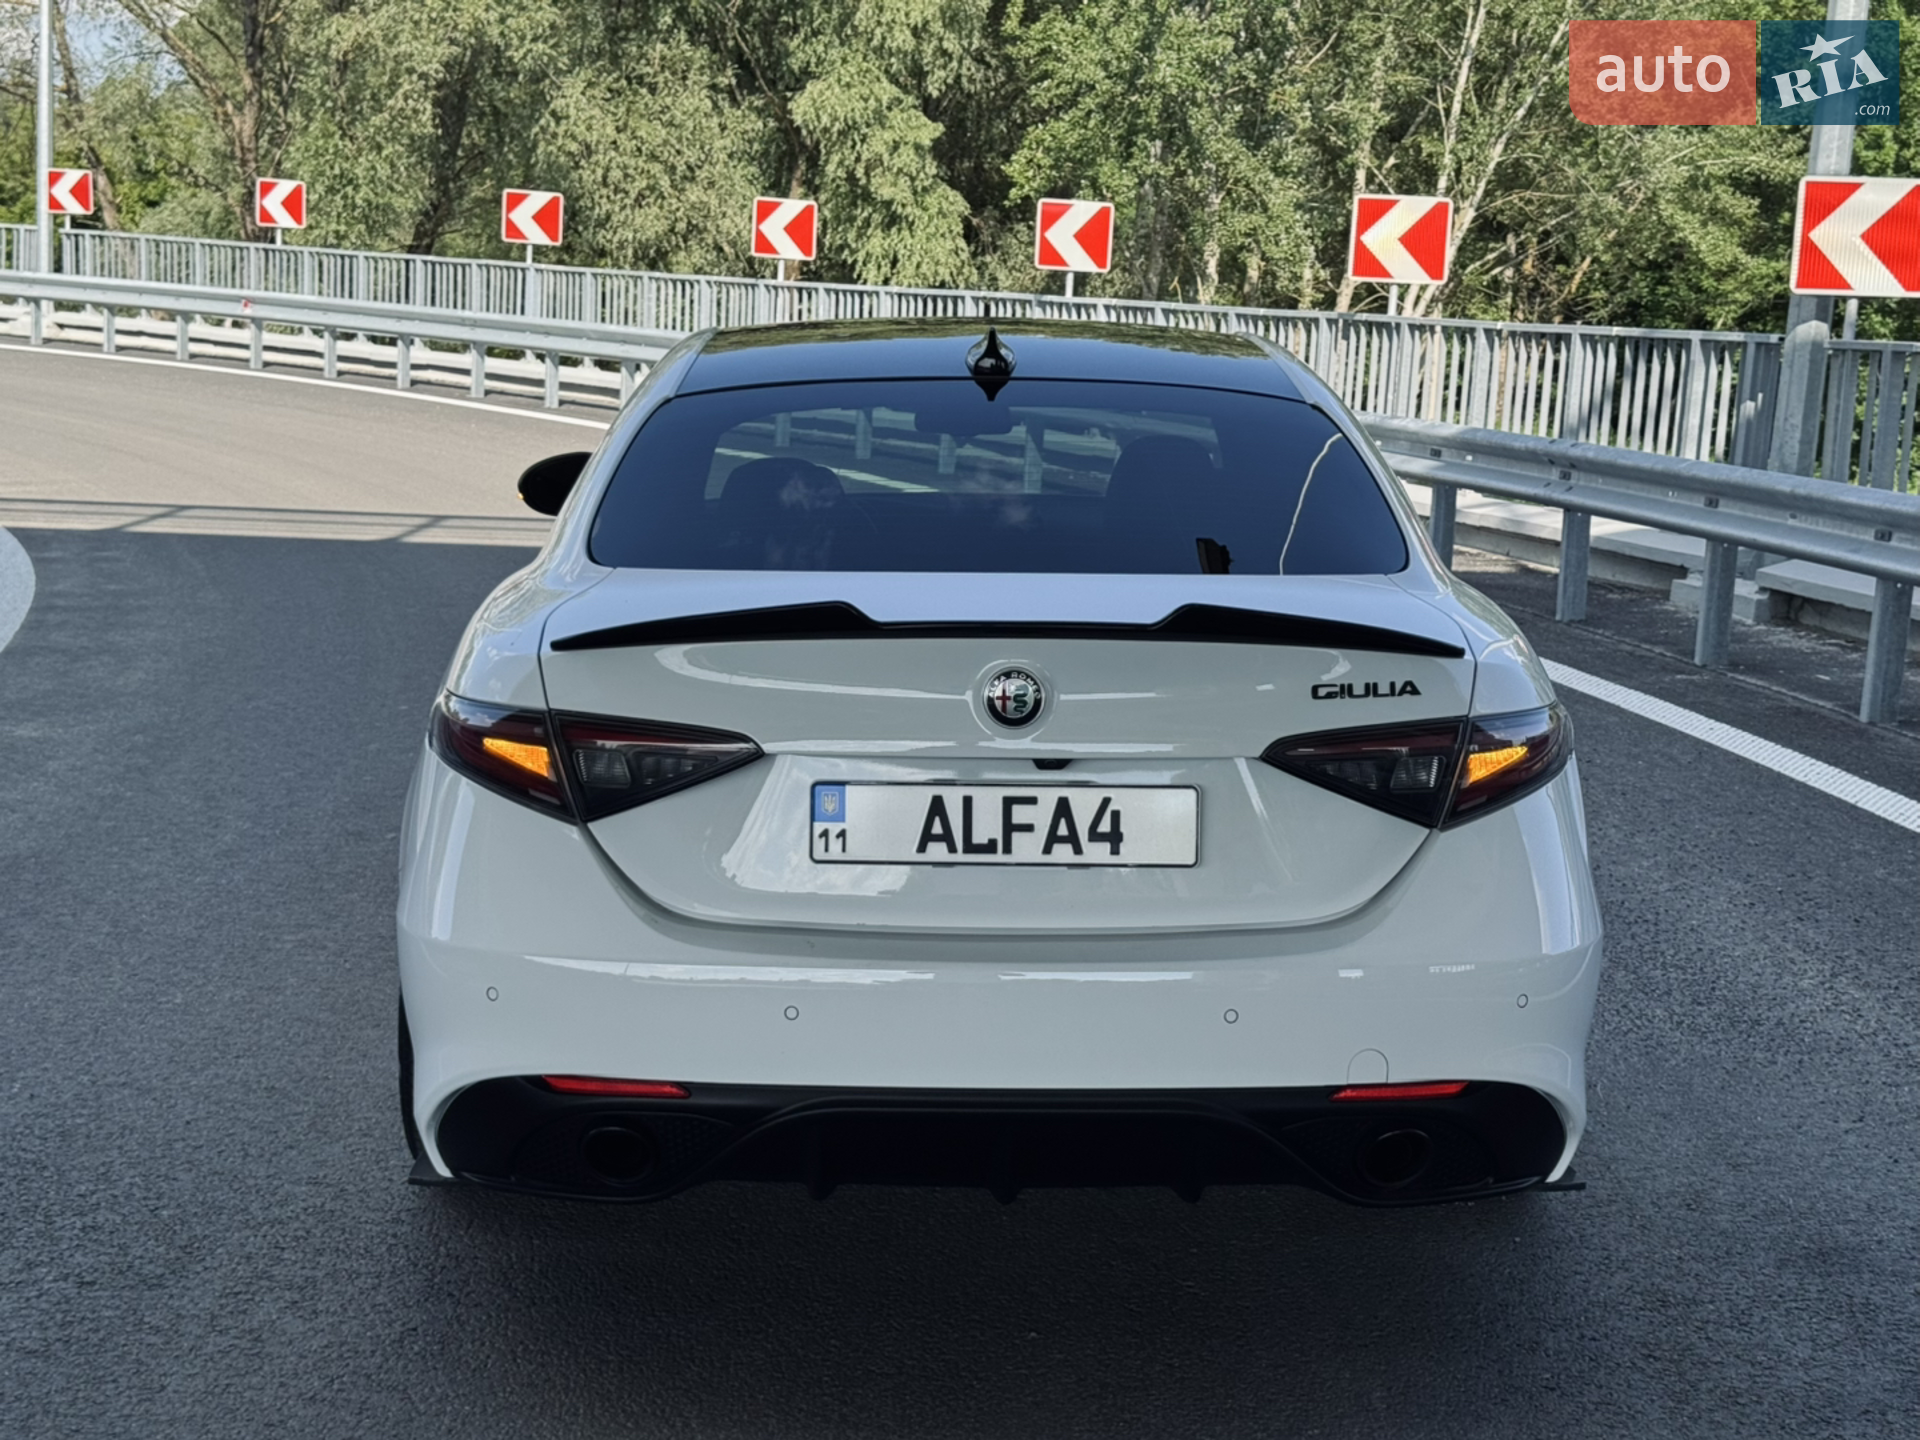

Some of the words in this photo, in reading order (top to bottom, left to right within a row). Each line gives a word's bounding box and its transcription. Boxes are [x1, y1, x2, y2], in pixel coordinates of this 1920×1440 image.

[1311, 680, 1422, 700] GIULIA
[915, 795, 1124, 856] ALFA4
[818, 828, 847, 853] 11
